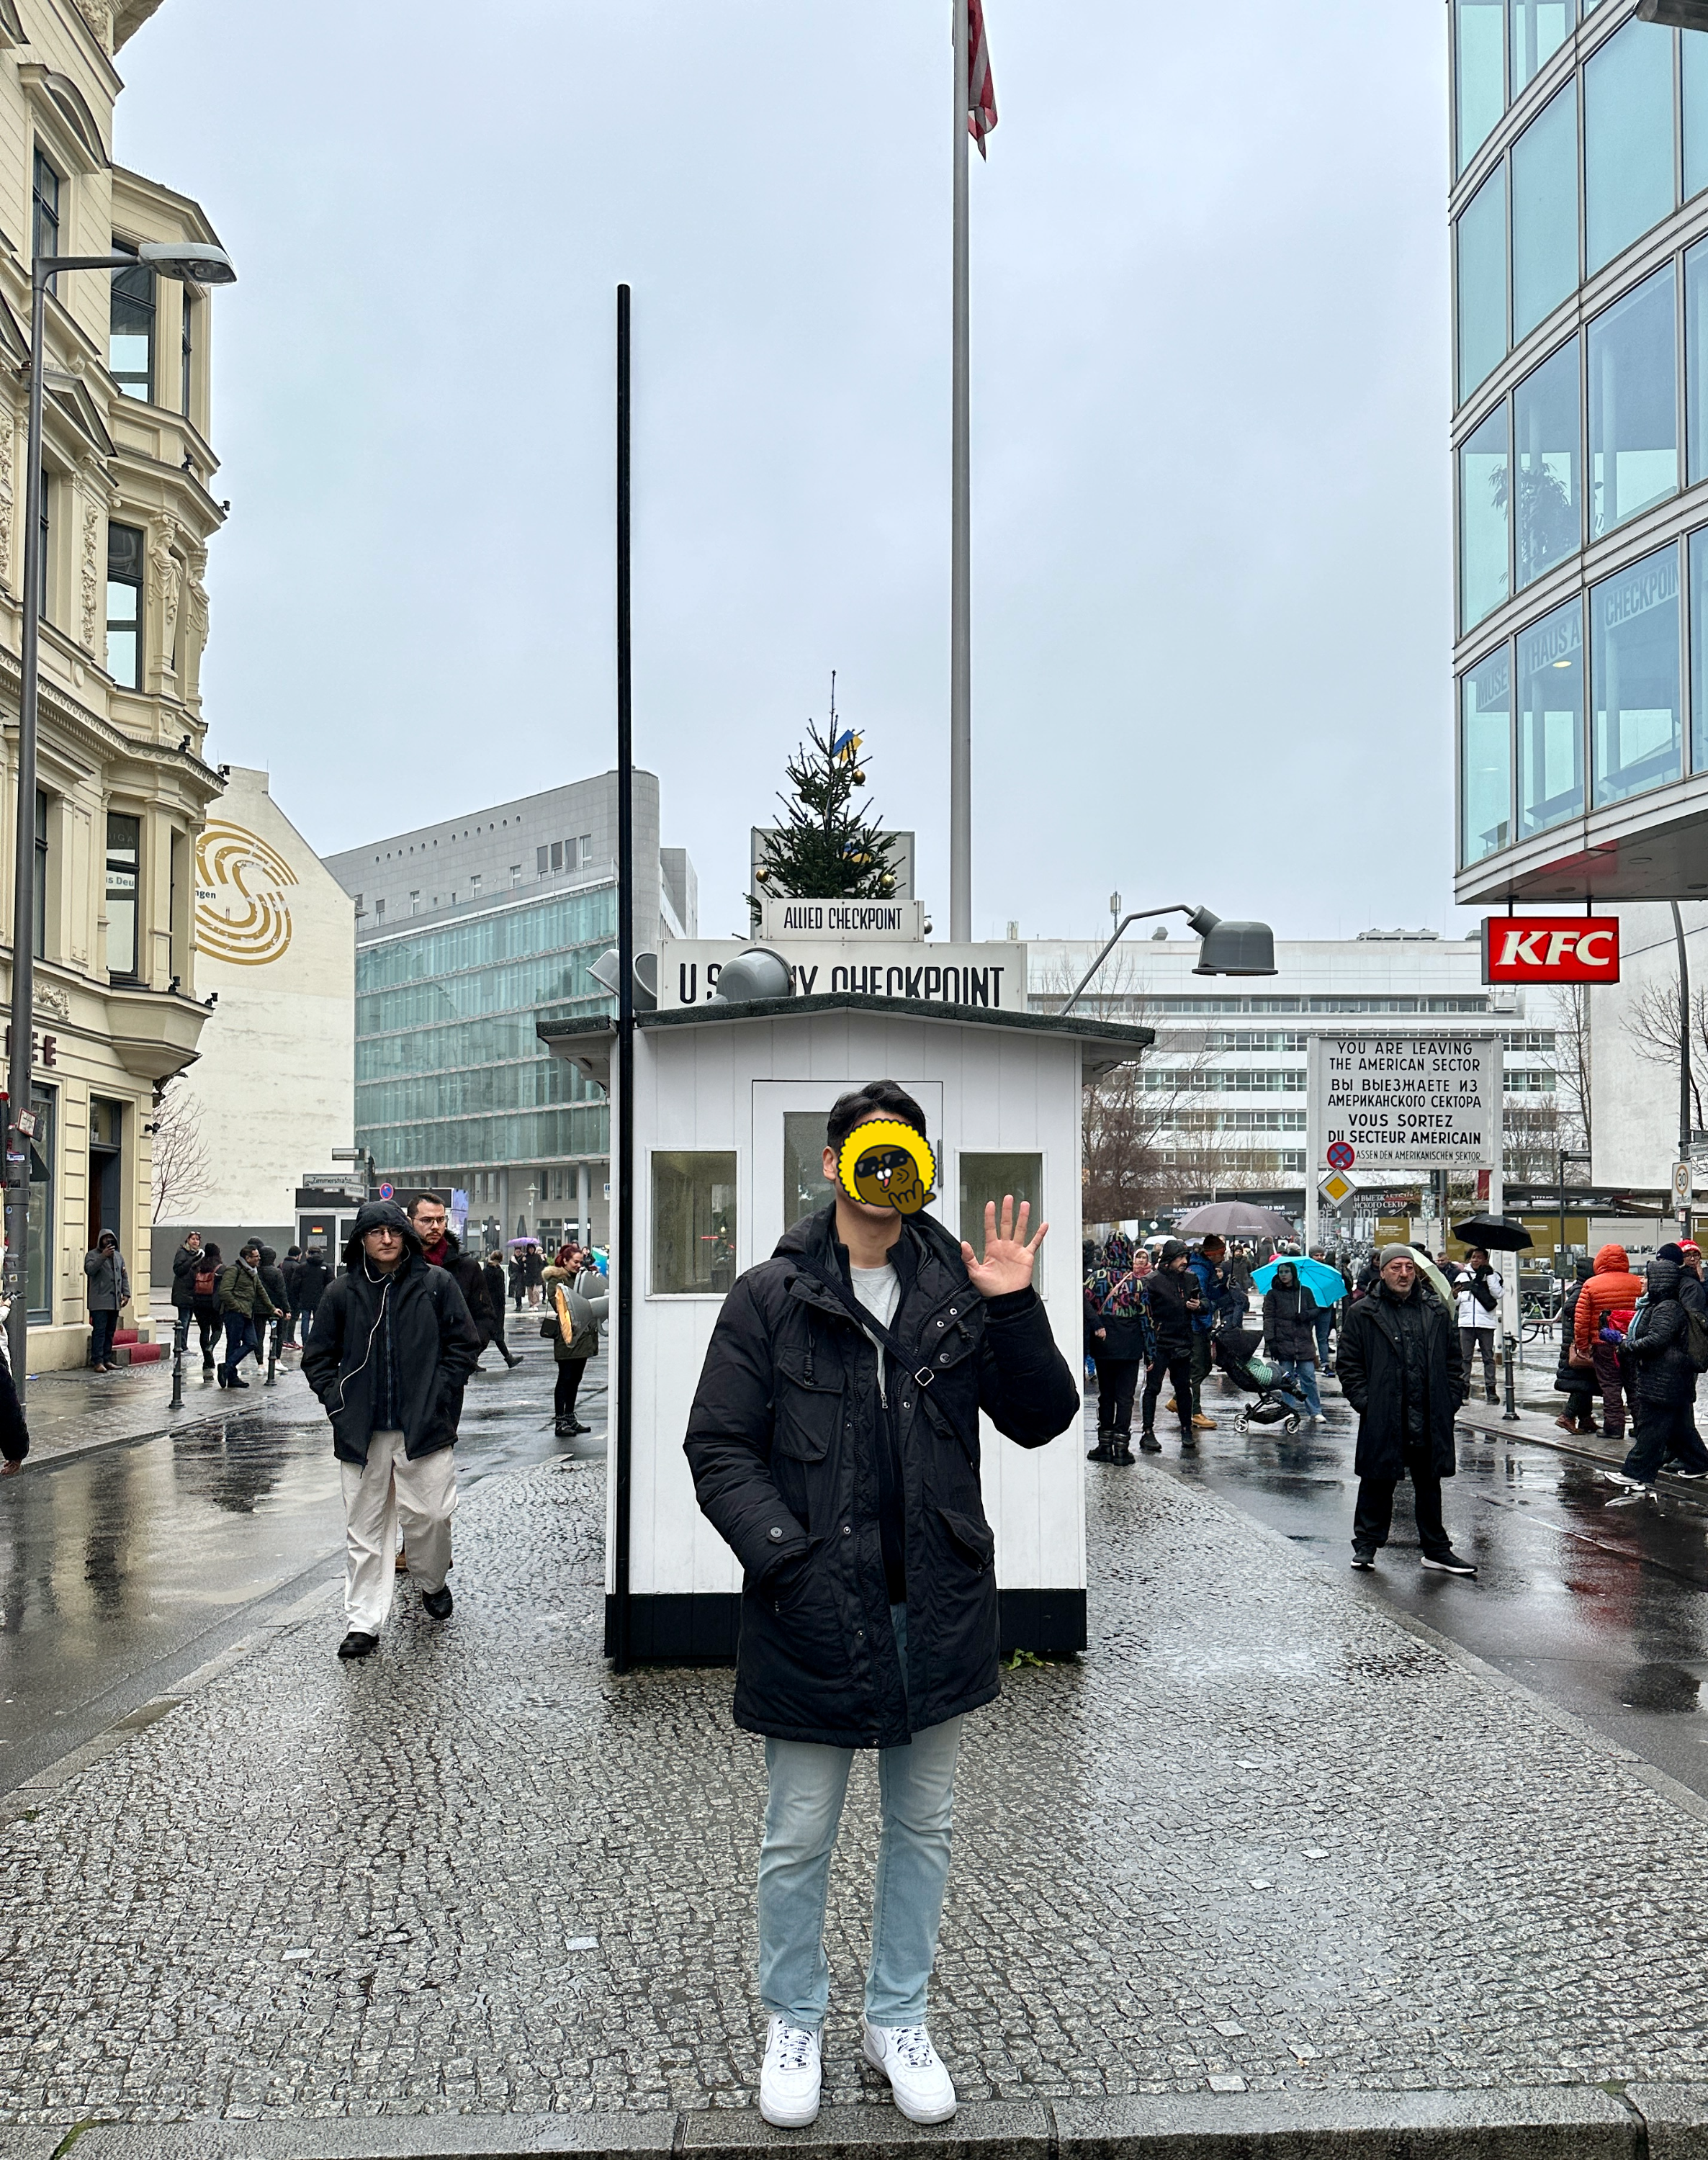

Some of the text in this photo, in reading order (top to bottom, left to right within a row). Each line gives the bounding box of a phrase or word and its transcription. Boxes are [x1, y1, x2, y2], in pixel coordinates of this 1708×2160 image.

[1532, 624, 1568, 670] HAUS
[1570, 616, 1581, 647] A
[1605, 562, 1678, 626] CHECKPOIN
[116, 876, 135, 886] Deu
[784, 907, 902, 930] ALLIED CHECKPOINT
[1496, 931, 1613, 966] KFC
[832, 966, 1004, 1007] CHECKPOINT
[1337, 1042, 1473, 1056] YOU ARE LEAVING
[1329, 1058, 1480, 1071] THE AMERICAN SECTOR
[1331, 1079, 1478, 1092] ВЫ ВЫЕЗЖАЕТЕ ИЗ
[1328, 1094, 1482, 1108] АМЕРИКАНСКОГО СЕКТОРА
[1348, 1114, 1453, 1128] VOUS SORTEZ
[1328, 1130, 1344, 1142] DU
[1349, 1130, 1406, 1143] SECTEUR
[1356, 1150, 1480, 1161] ASSEN DEN AMERIKANISCHEN SEKTOR
[1678, 1174, 1686, 1187] 30
